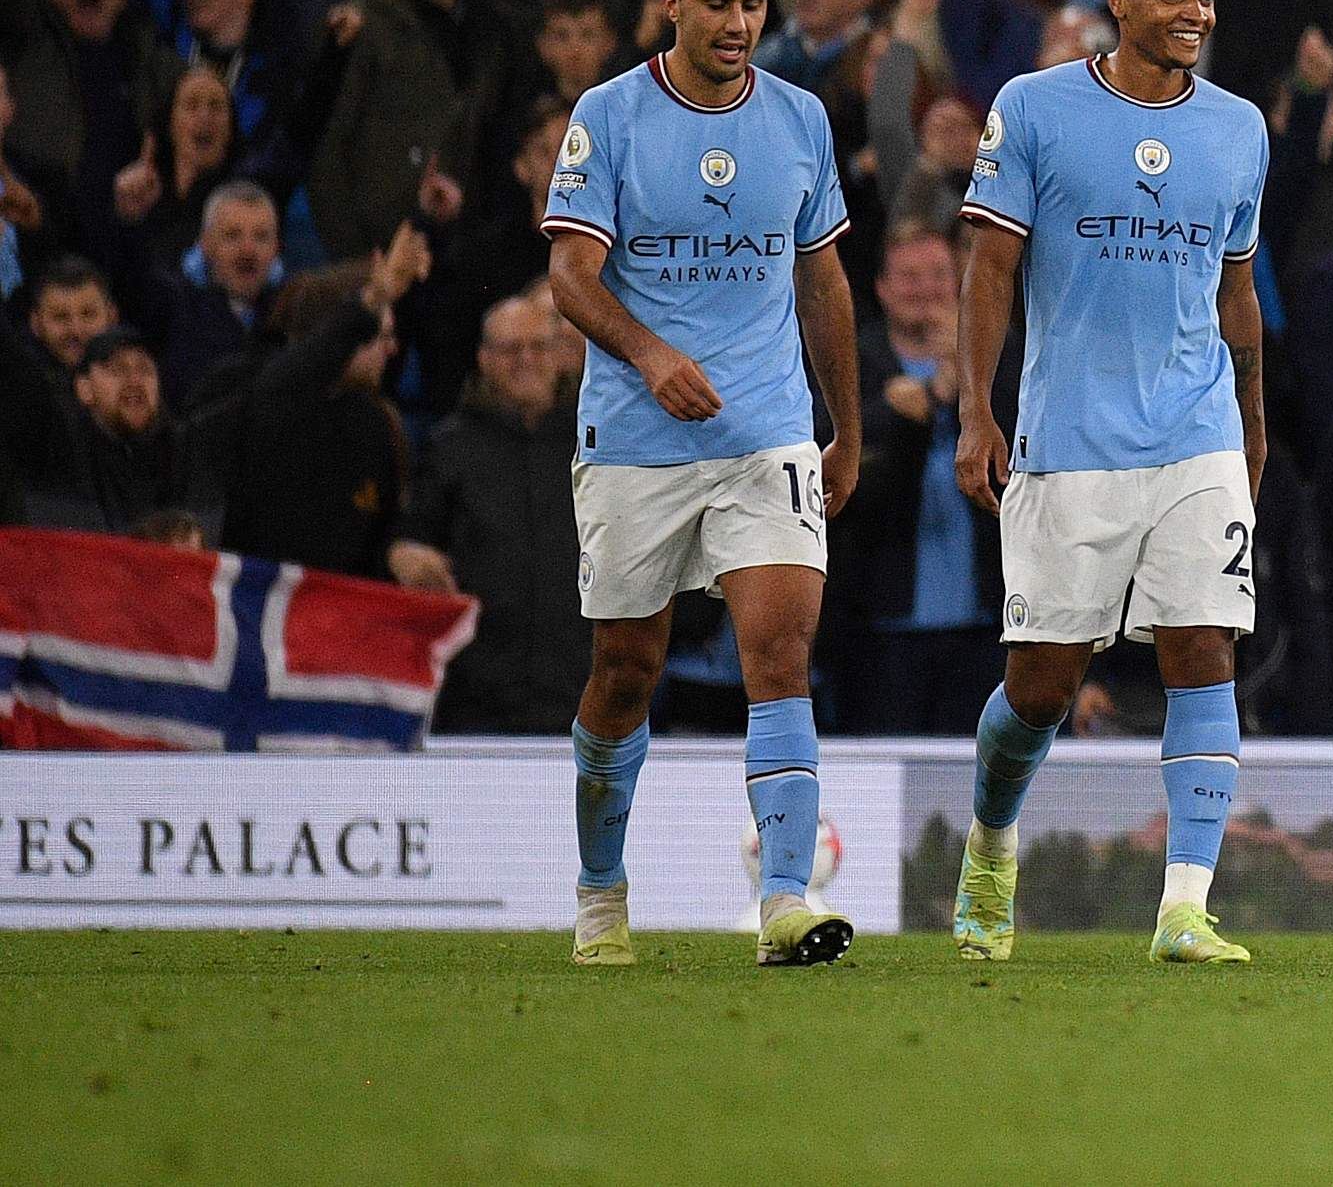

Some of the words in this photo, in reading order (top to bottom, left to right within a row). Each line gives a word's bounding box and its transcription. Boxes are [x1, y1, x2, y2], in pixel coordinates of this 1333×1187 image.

[1076, 216, 1213, 247] ETIHAD
[628, 233, 786, 258] ETIHAD
[1099, 246, 1189, 266] AIRWAYS
[659, 266, 766, 282] AIRWAYS
[781, 462, 824, 521] 16
[756, 813, 785, 832] CITY
[0, 815, 97, 877] ES
[138, 817, 432, 877] PALACE
